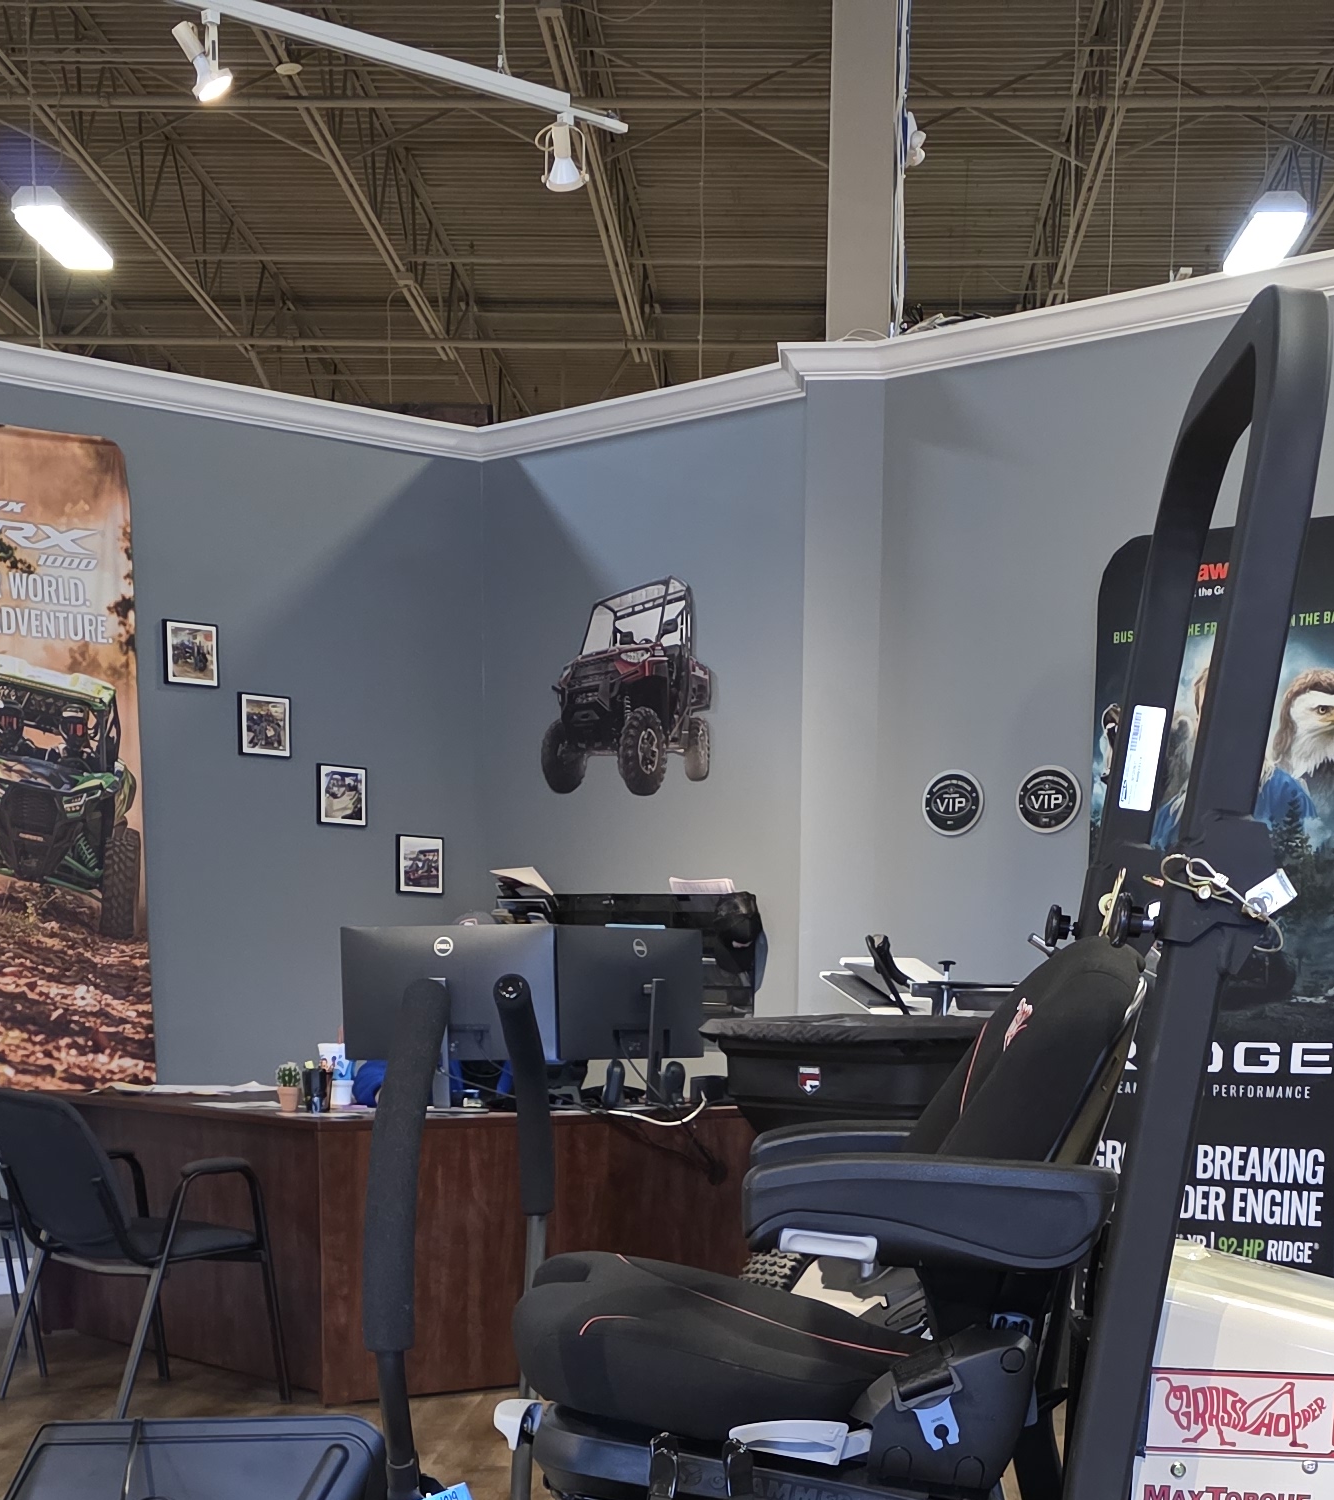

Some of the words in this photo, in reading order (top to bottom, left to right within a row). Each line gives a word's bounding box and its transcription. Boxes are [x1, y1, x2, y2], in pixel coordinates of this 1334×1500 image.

[37, 554, 98, 570] 1000
[8, 571, 91, 607] WORLD.
[1187, 623, 1202, 637] HE
[1299, 611, 1320, 626] THE
[936, 797, 967, 812] VIP
[1030, 793, 1063, 809] VIP
[1212, 1084, 1312, 1099] PERFORMANCE
[1195, 1144, 1326, 1185] BREAKING
[1232, 1188, 1325, 1228] ENGINE
[1218, 1236, 1265, 1259] 92-HP
